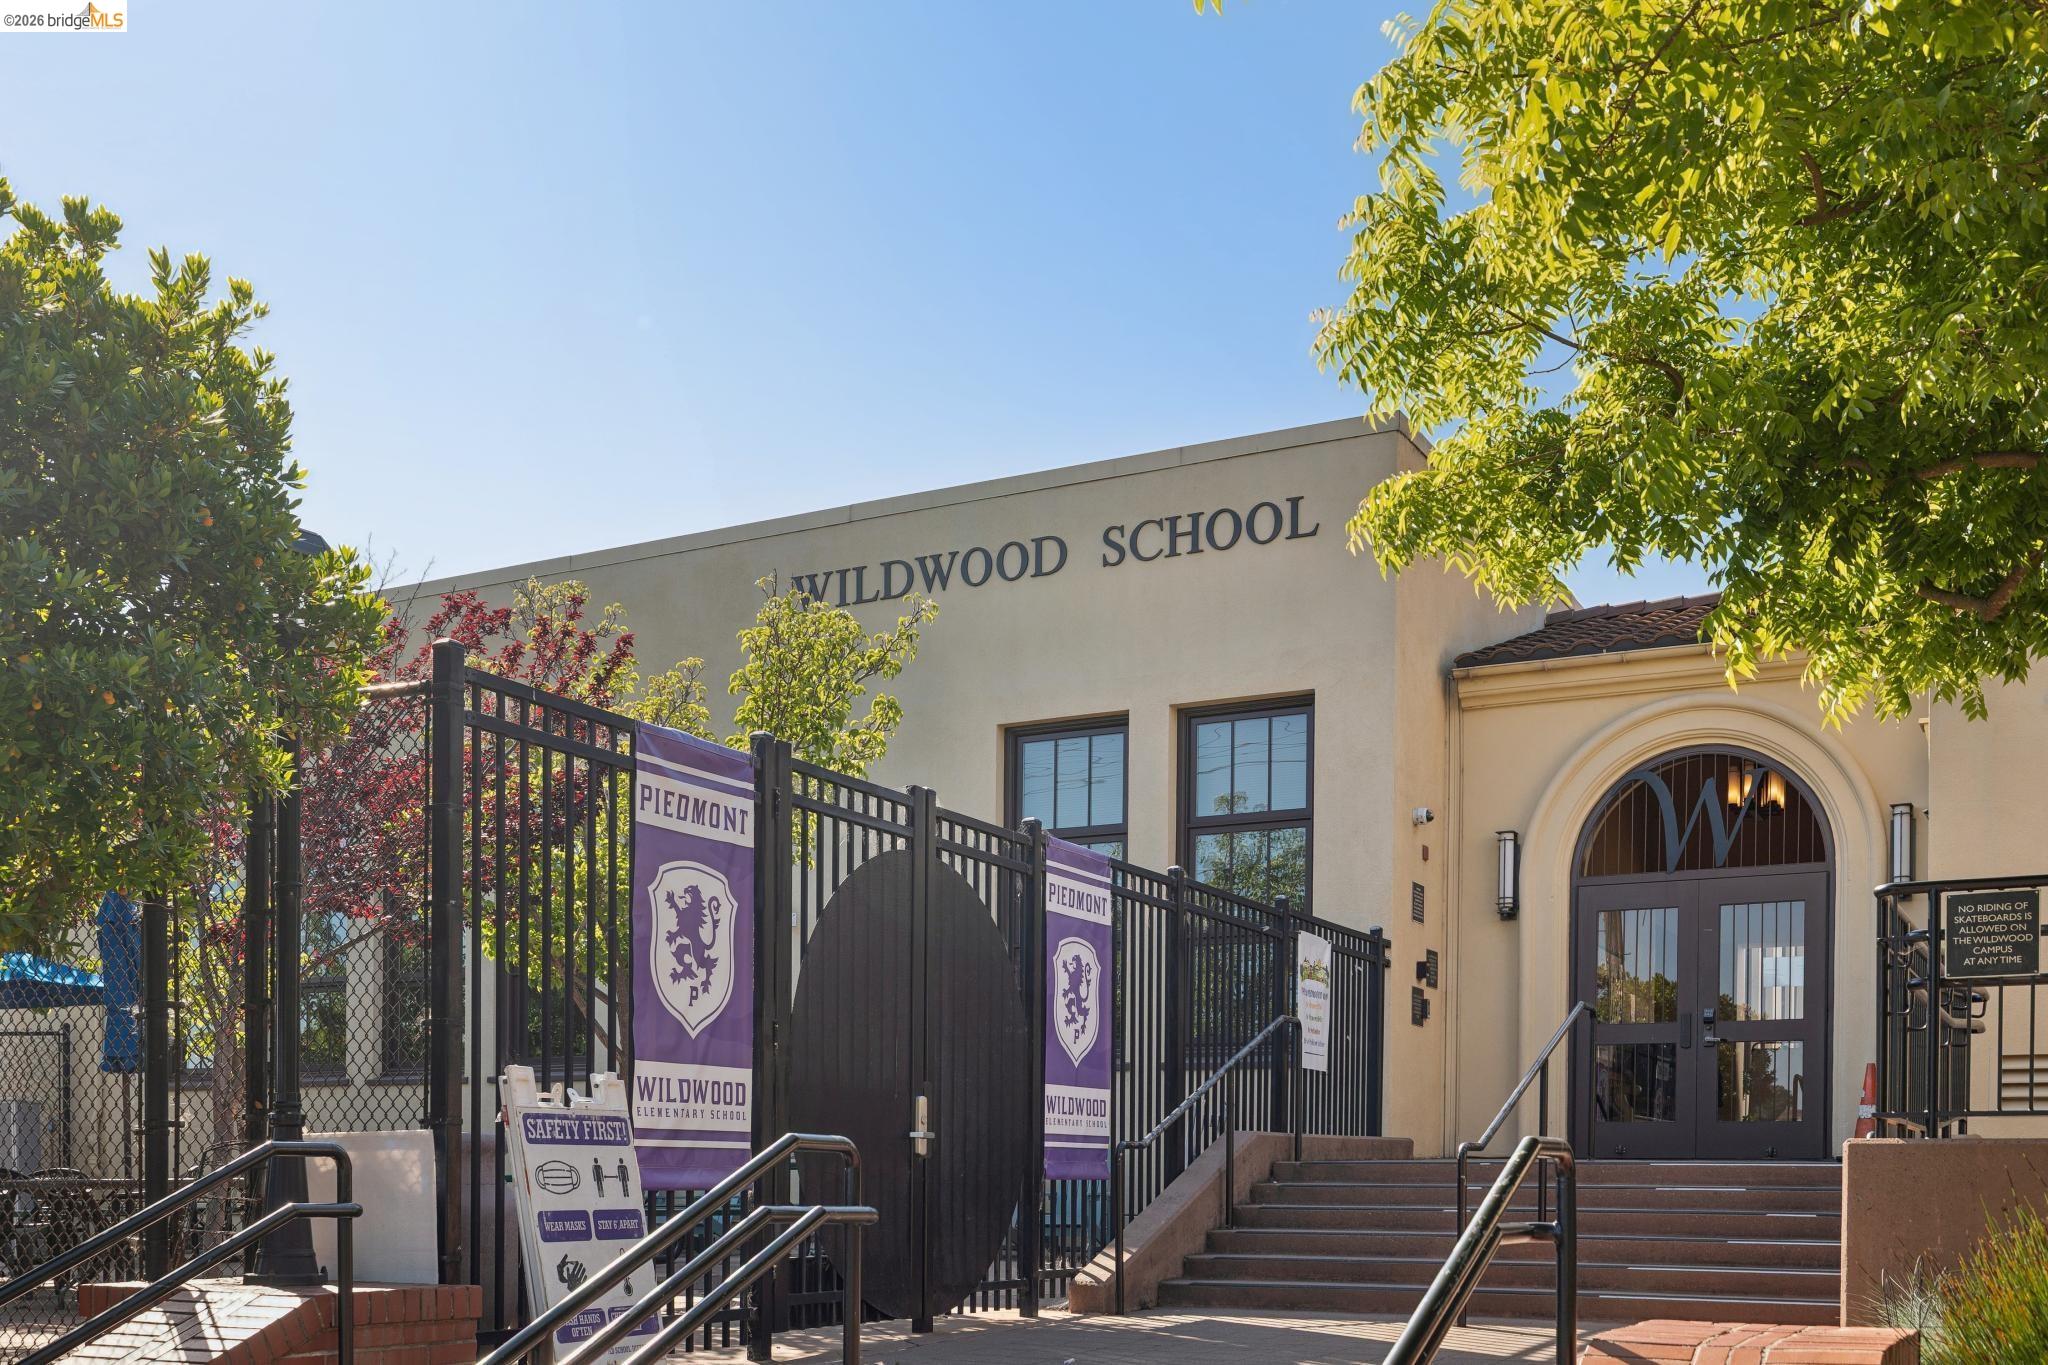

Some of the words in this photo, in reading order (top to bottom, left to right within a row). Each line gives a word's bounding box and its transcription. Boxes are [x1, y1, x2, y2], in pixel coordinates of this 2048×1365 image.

[791, 536, 1068, 612] WILDWOOD
[1102, 496, 1319, 567] SCHOOL
[640, 783, 749, 835] PIEDMONT
[1613, 767, 1770, 875] W
[1049, 882, 1108, 917] PIEDMONT
[1958, 905, 1975, 913] NO
[1977, 902, 2012, 912] RIDING
[2014, 901, 2029, 910] OF
[1954, 914, 2022, 924] SKATEBOARDS
[2024, 911, 2033, 920] IS
[1959, 925, 2007, 934] ALLOWED
[2010, 923, 2027, 931] ON
[1952, 937, 1971, 945] THE
[1972, 933, 2034, 944] WILDWOOD
[1972, 945, 2013, 955] CAMPUS
[1963, 957, 1976, 966] AT
[1977, 957, 1999, 965] ANY
[1999, 955, 2023, 964] TIME
[688, 985, 699, 1007] P
[1073, 1028, 1080, 1045] P
[636, 1075, 747, 1106] WILDWOOD
[1046, 1095, 1107, 1117] WILDWOOD
[636, 1106, 705, 1119] ELEMENTARY
[710, 1109, 747, 1121] SCHOOL
[526, 1118, 580, 1140] SAFETY
[582, 1120, 627, 1141] FIRST!
[1045, 1117, 1083, 1127] ELEMENTARY
[1085, 1119, 1107, 1129] SCHOOL
[544, 1221, 564, 1232] WEAR
[564, 1220, 587, 1231] MASKS
[597, 1220, 612, 1230] STAY
[619, 1219, 639, 1229] APART
[578, 1313, 601, 1325] HANDS
[571, 1326, 593, 1337] OFTEN
